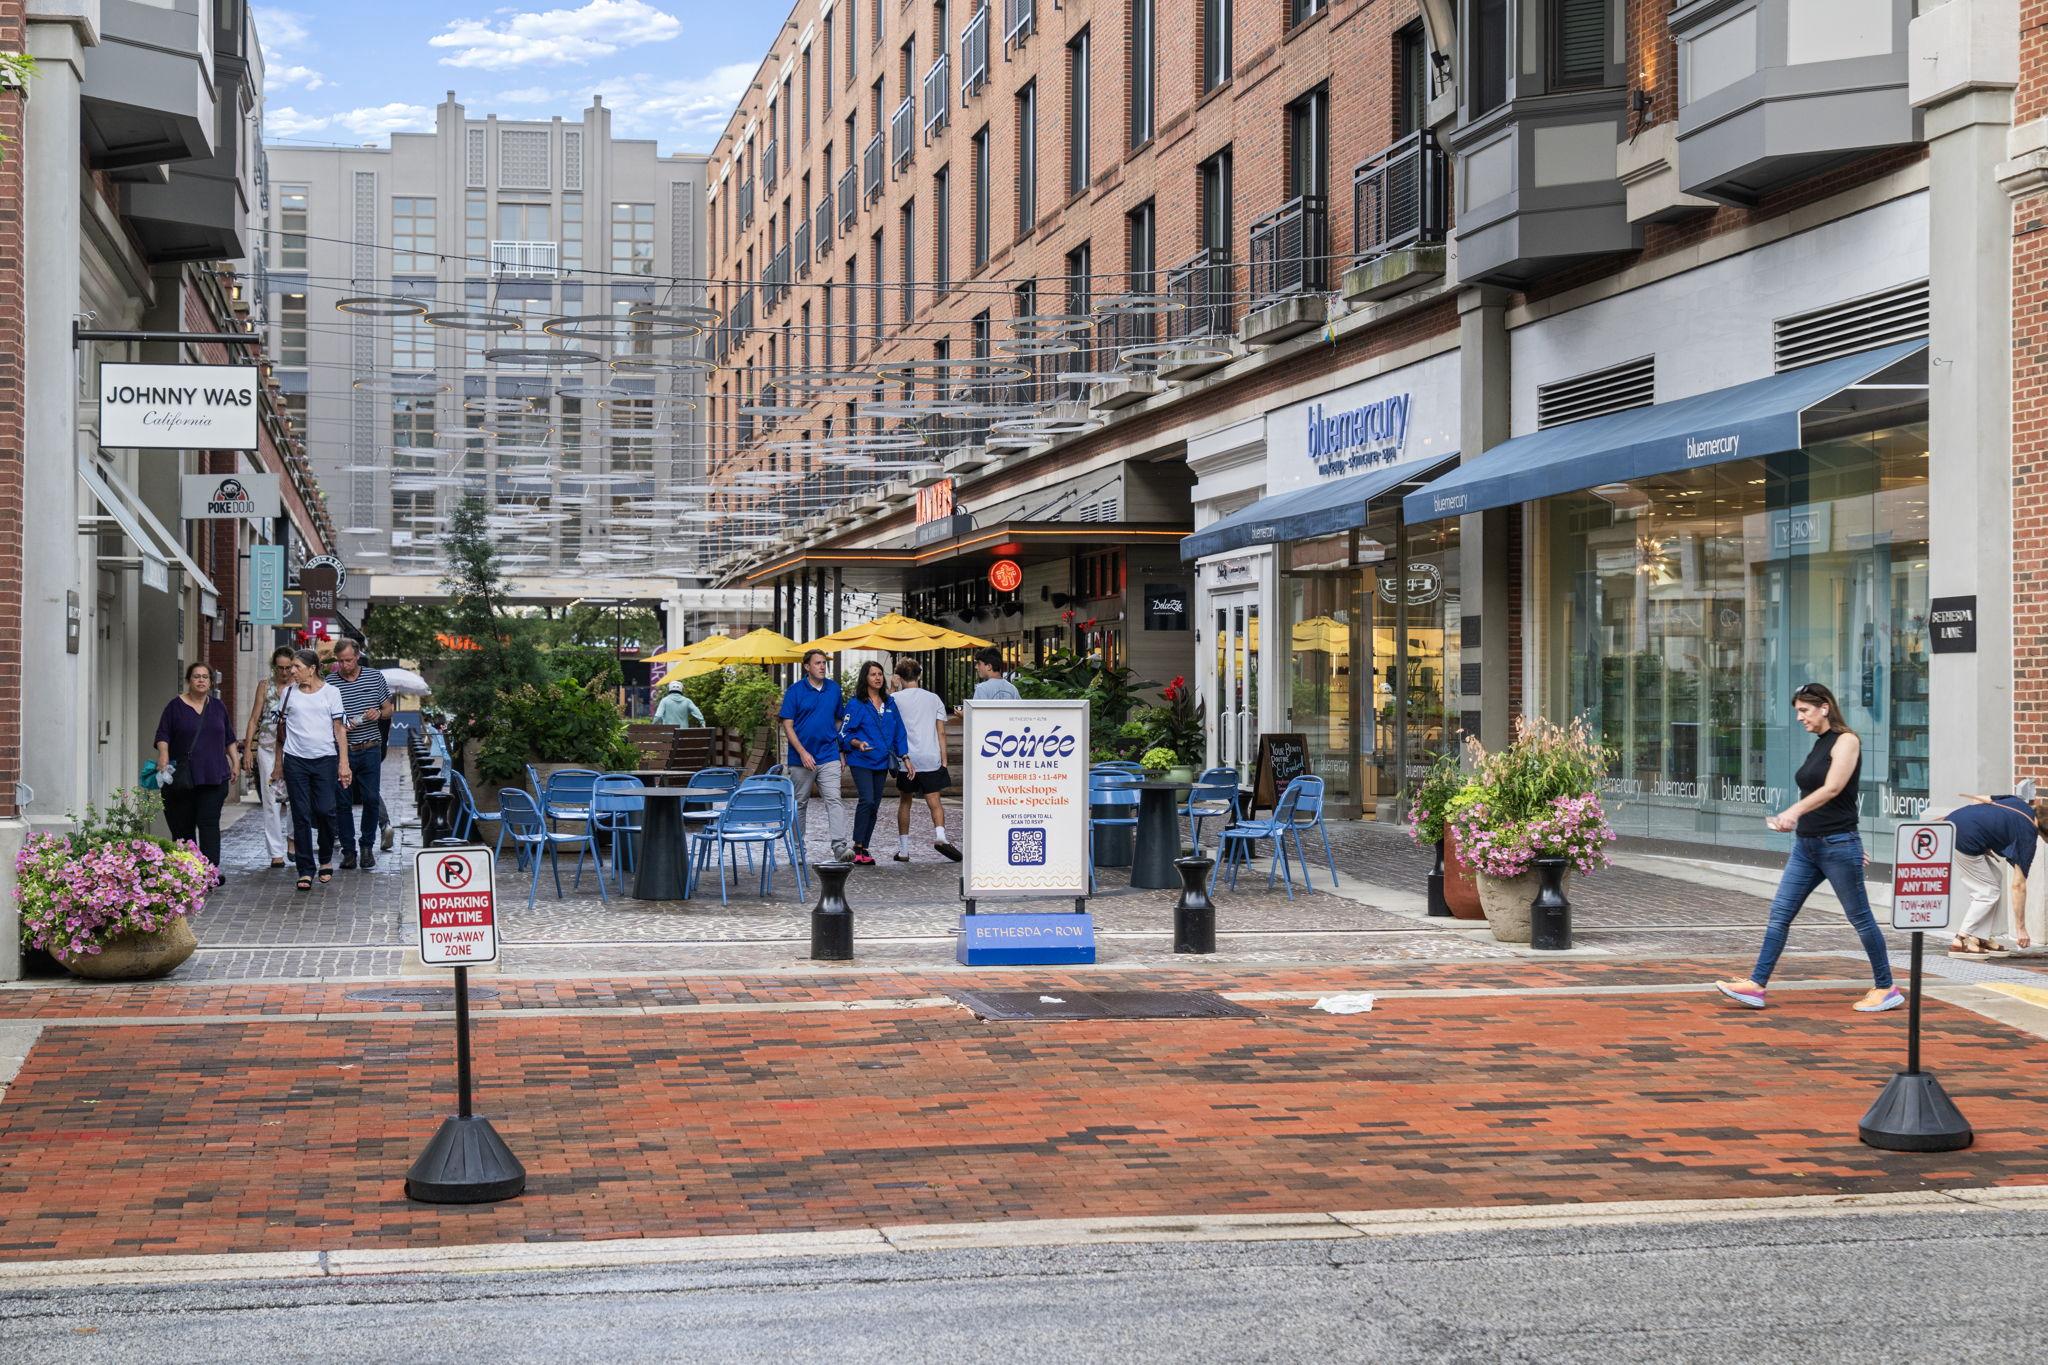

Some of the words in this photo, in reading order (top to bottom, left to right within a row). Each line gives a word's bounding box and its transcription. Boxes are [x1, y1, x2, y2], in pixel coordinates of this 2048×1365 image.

[107, 386, 197, 405] JOHNNY
[203, 388, 252, 407] WAS
[143, 410, 213, 431] California
[1307, 393, 1410, 458] bluemercury
[1687, 434, 1740, 459] bluemercury
[1433, 494, 1468, 512] bluemercury
[261, 559, 273, 612] MORLEY
[1931, 609, 1973, 623] BETHESDA
[1941, 626, 1964, 639] LANE
[980, 725, 1076, 758] Soirée
[996, 760, 1009, 769] ON
[1013, 760, 1031, 769] THE
[1034, 760, 1059, 769] LANE
[987, 773, 1027, 781] SEPTEMBER
[998, 785, 1058, 796] Workshops
[1654, 773, 1709, 805] bluemercury
[1721, 777, 1782, 809] bluemercury
[986, 797, 1018, 806] Music
[1025, 796, 1070, 807] Specials
[1881, 785, 1930, 815] bluemer
[1897, 867, 1910, 879] NO
[1910, 867, 1948, 879] PARKING
[1901, 881, 1922, 893] ANY
[1922, 881, 1943, 892] TIME
[422, 897, 437, 910] NO
[439, 895, 489, 909] PARKING
[1900, 899, 1942, 911] TOW-AWAY
[430, 911, 455, 925] ANY
[456, 910, 483, 923] TIME
[1910, 912, 1931, 923] ZONE
[429, 931, 485, 944] TOW-AWAY
[976, 926, 1041, 938] BETHESDA
[1055, 925, 1084, 937] ROW
[445, 944, 472, 956] ZONE
